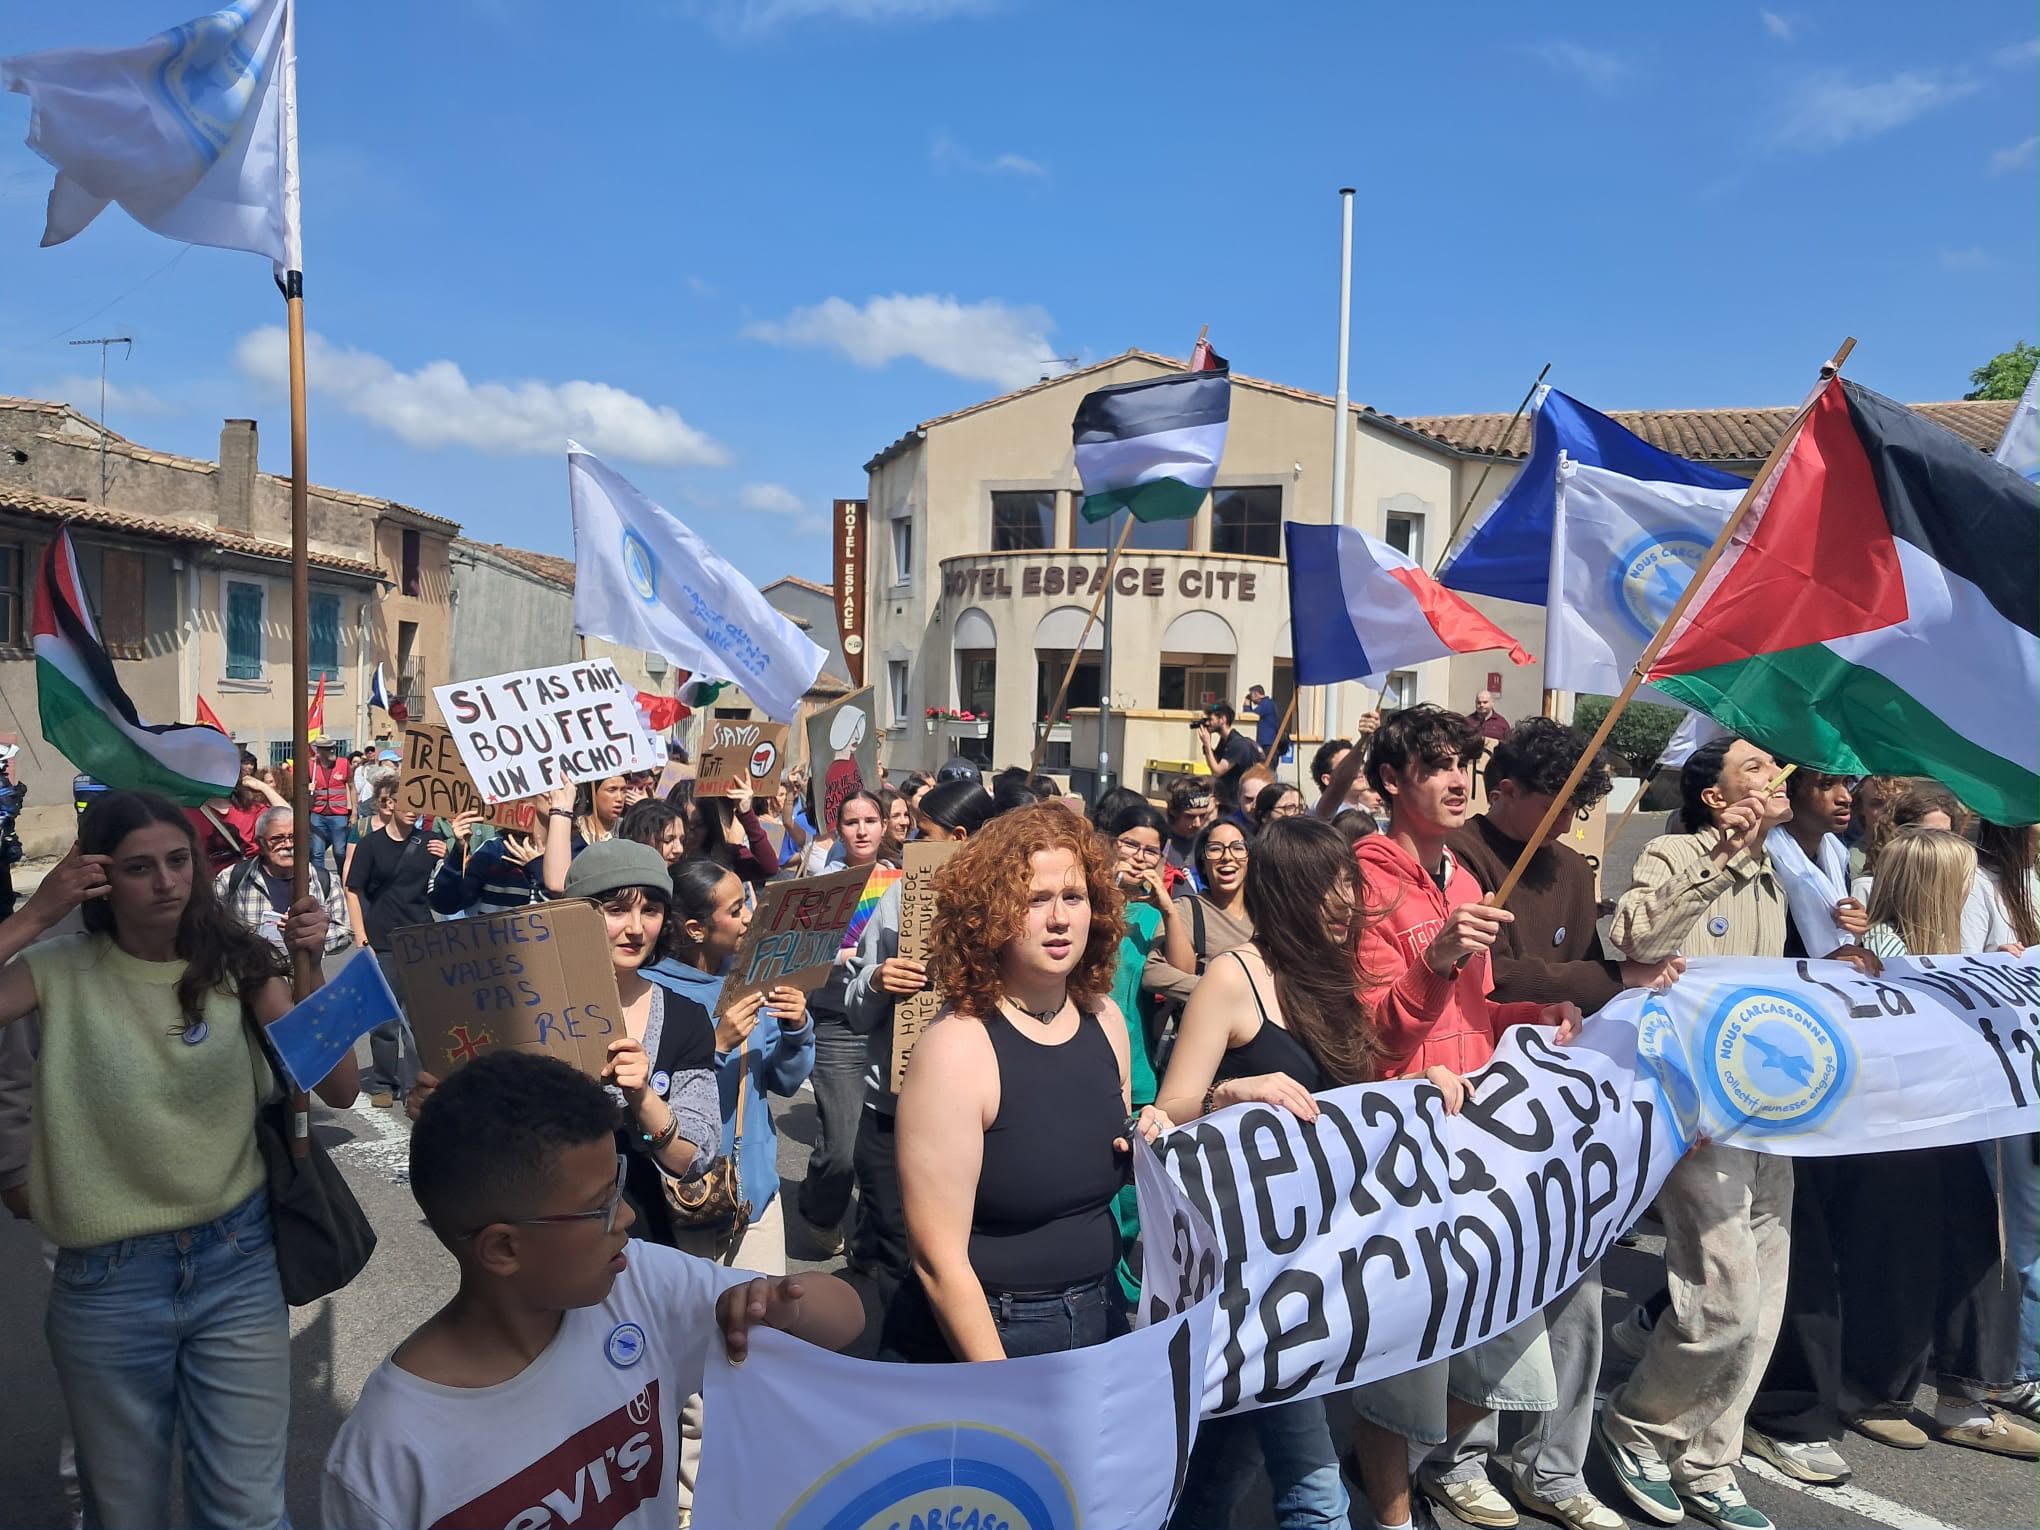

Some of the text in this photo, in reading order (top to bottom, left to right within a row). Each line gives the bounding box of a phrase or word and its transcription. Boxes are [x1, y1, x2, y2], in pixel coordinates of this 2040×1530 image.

[844, 503, 857, 558] HOTEL
[945, 566, 1257, 601] HOTEL ESPACE CITE
[1630, 552, 1659, 579] NOUS
[843, 564, 855, 629] ESPACE
[502, 675, 571, 712] T'AS
[469, 703, 628, 763] BOUFFE
[488, 766, 530, 797] UN
[771, 882, 865, 932] FREE
[441, 954, 524, 986] VALES
[1796, 960, 1916, 1018] La
[473, 981, 541, 1011] PAS
[534, 1004, 612, 1045] RES
[1720, 1002, 1828, 1060] NOUS CARCASSONNE
[1724, 1055, 1836, 1114] collectif jeunesse engagé
